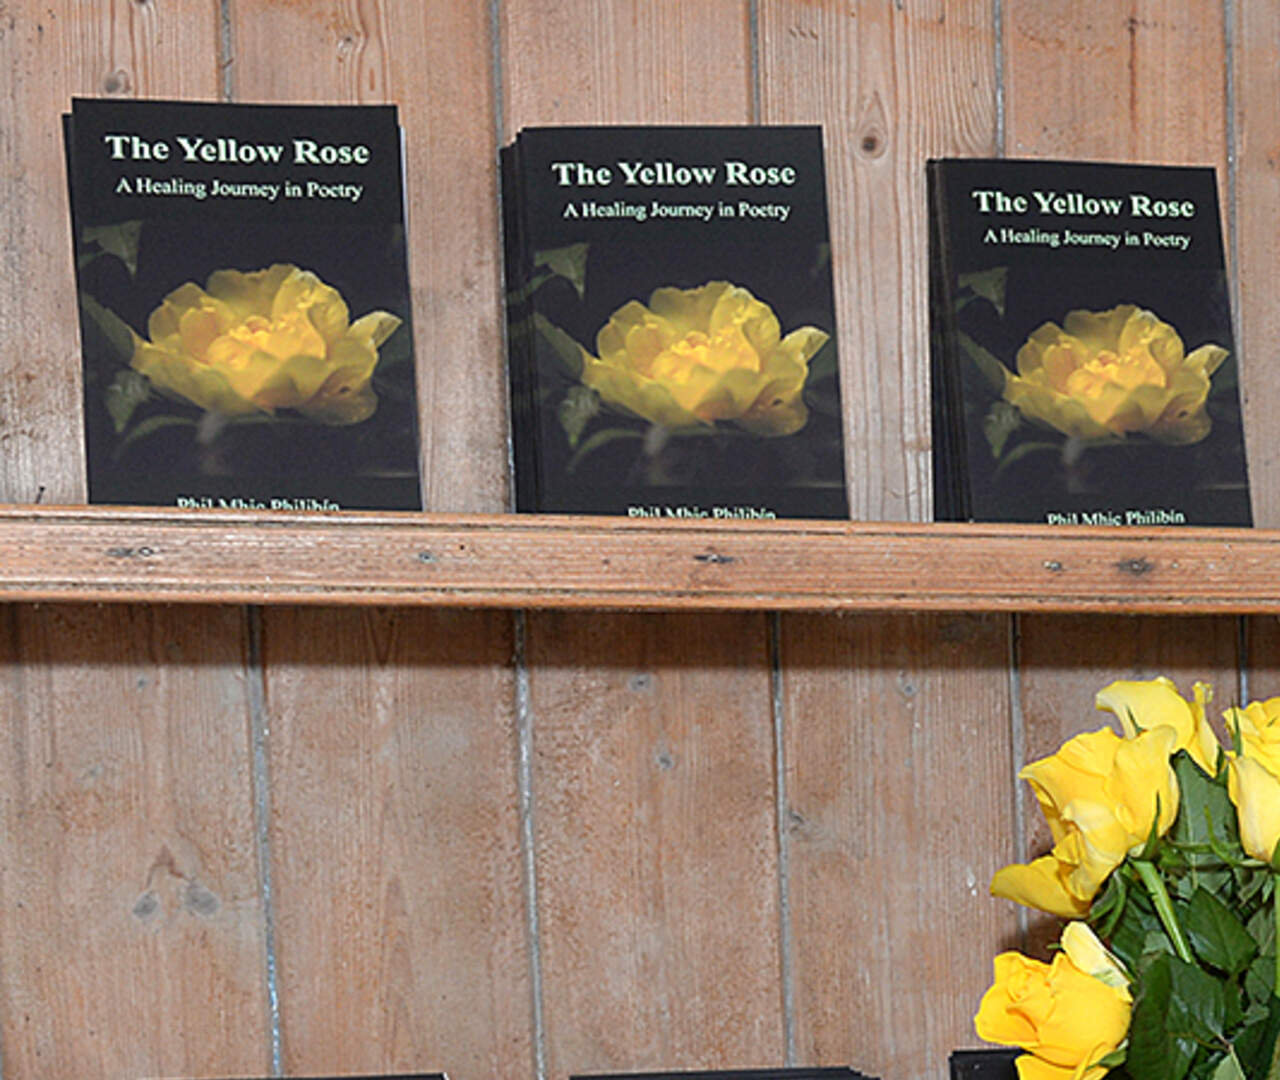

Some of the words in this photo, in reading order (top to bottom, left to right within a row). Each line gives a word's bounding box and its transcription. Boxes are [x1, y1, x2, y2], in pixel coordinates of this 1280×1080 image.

[104, 135, 169, 160] The
[177, 137, 284, 163] Yellow
[293, 140, 369, 164] Rose
[551, 163, 611, 185] The
[618, 162, 716, 185] Yellow
[725, 162, 796, 185] Rose
[116, 177, 133, 193] A
[136, 177, 207, 199] Healing
[210, 179, 280, 201] Journey
[284, 181, 303, 197] in
[306, 181, 363, 202] Poetry
[563, 203, 579, 218] A
[582, 201, 647, 221] Healing
[650, 201, 714, 221] Journey
[718, 201, 735, 217] in
[738, 201, 791, 222] Poetry
[972, 191, 1028, 213] The
[1033, 191, 1122, 215] Yellow
[1130, 195, 1194, 217] Rose
[983, 229, 998, 243] A
[1000, 228, 1060, 248] Healing
[1063, 229, 1121, 249] Journey
[1124, 231, 1140, 246] in
[1143, 232, 1191, 251] Poetry
[1047, 513, 1078, 526] Phil
